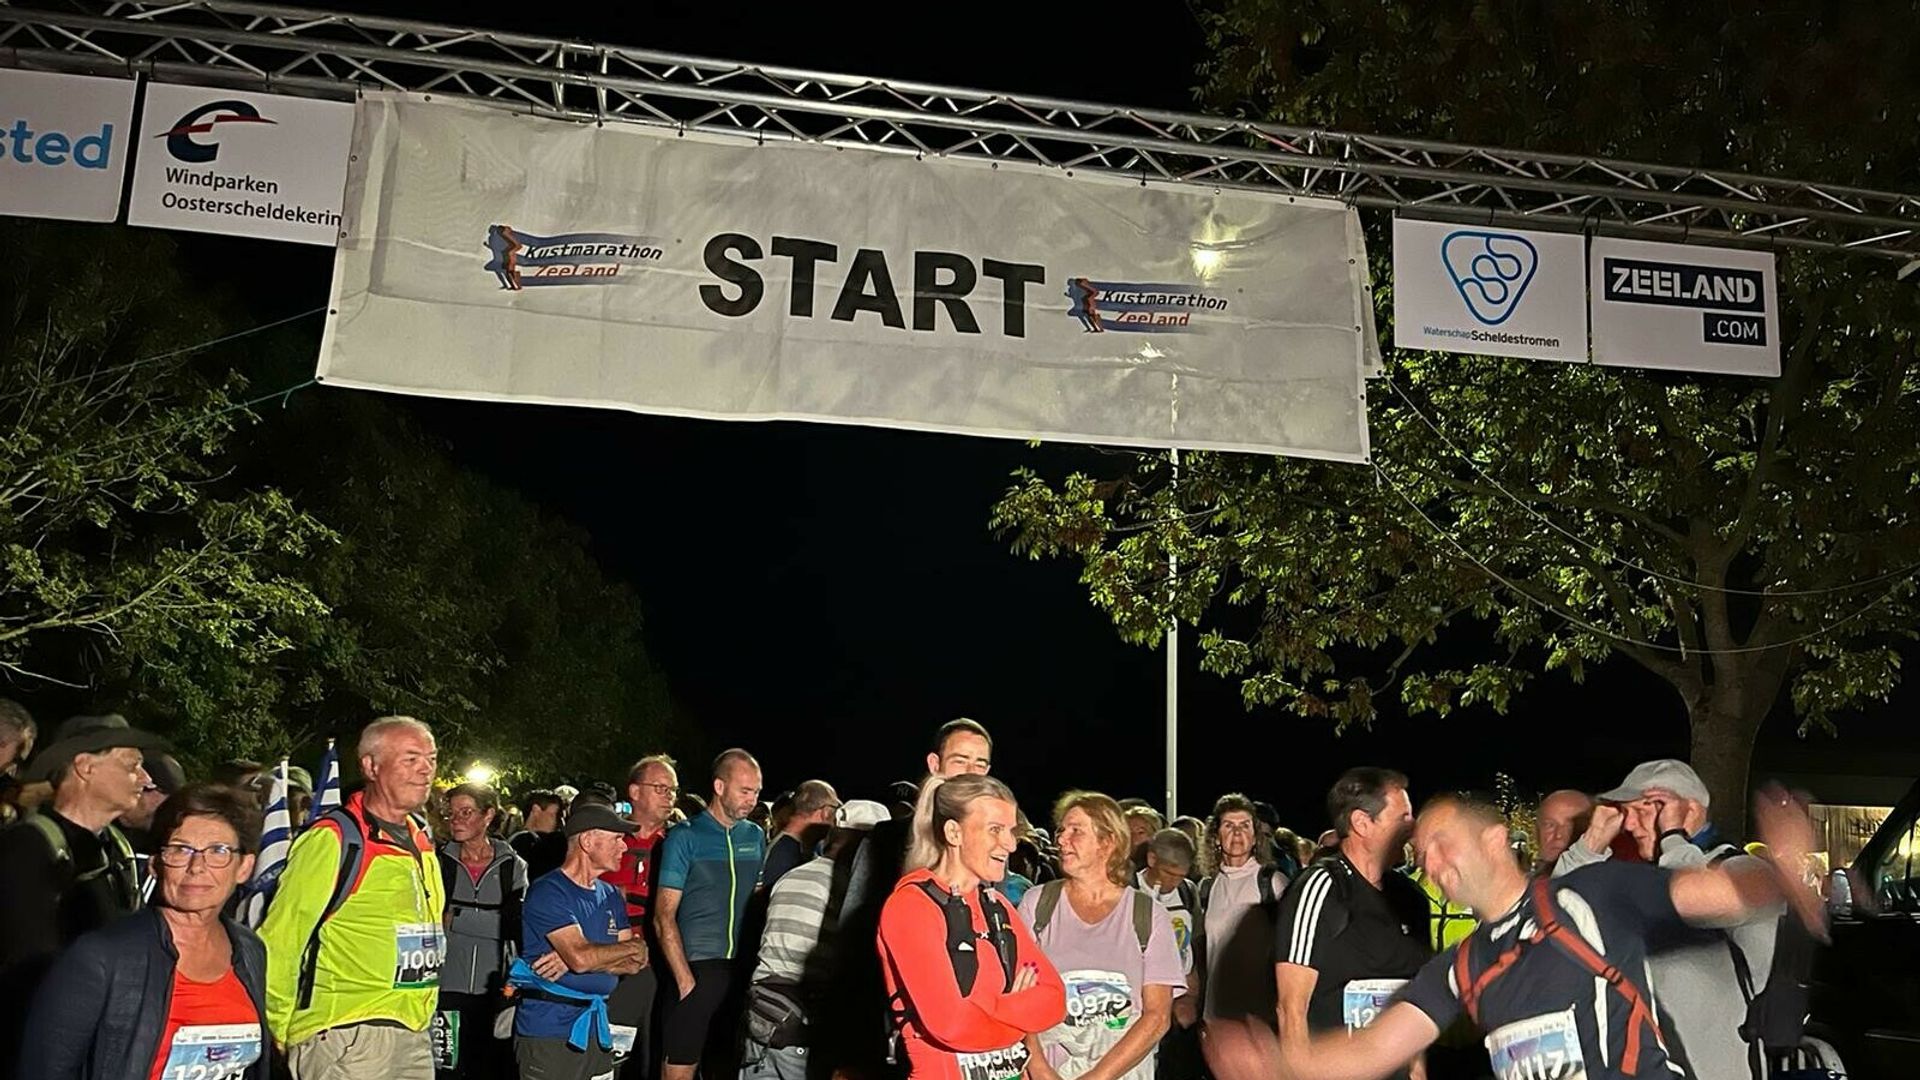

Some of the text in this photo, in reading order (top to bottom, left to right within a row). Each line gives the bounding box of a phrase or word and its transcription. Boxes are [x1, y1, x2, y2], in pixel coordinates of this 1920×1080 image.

[165, 166, 279, 195] Windparken
[161, 191, 342, 226] Oosterscheldekerin
[525, 242, 663, 260] Kustmarathon
[698, 232, 1046, 338] START
[1611, 266, 1757, 304] ZEELAND
[1103, 290, 1228, 311] Kustmarathon
[1711, 319, 1760, 340] .COM
